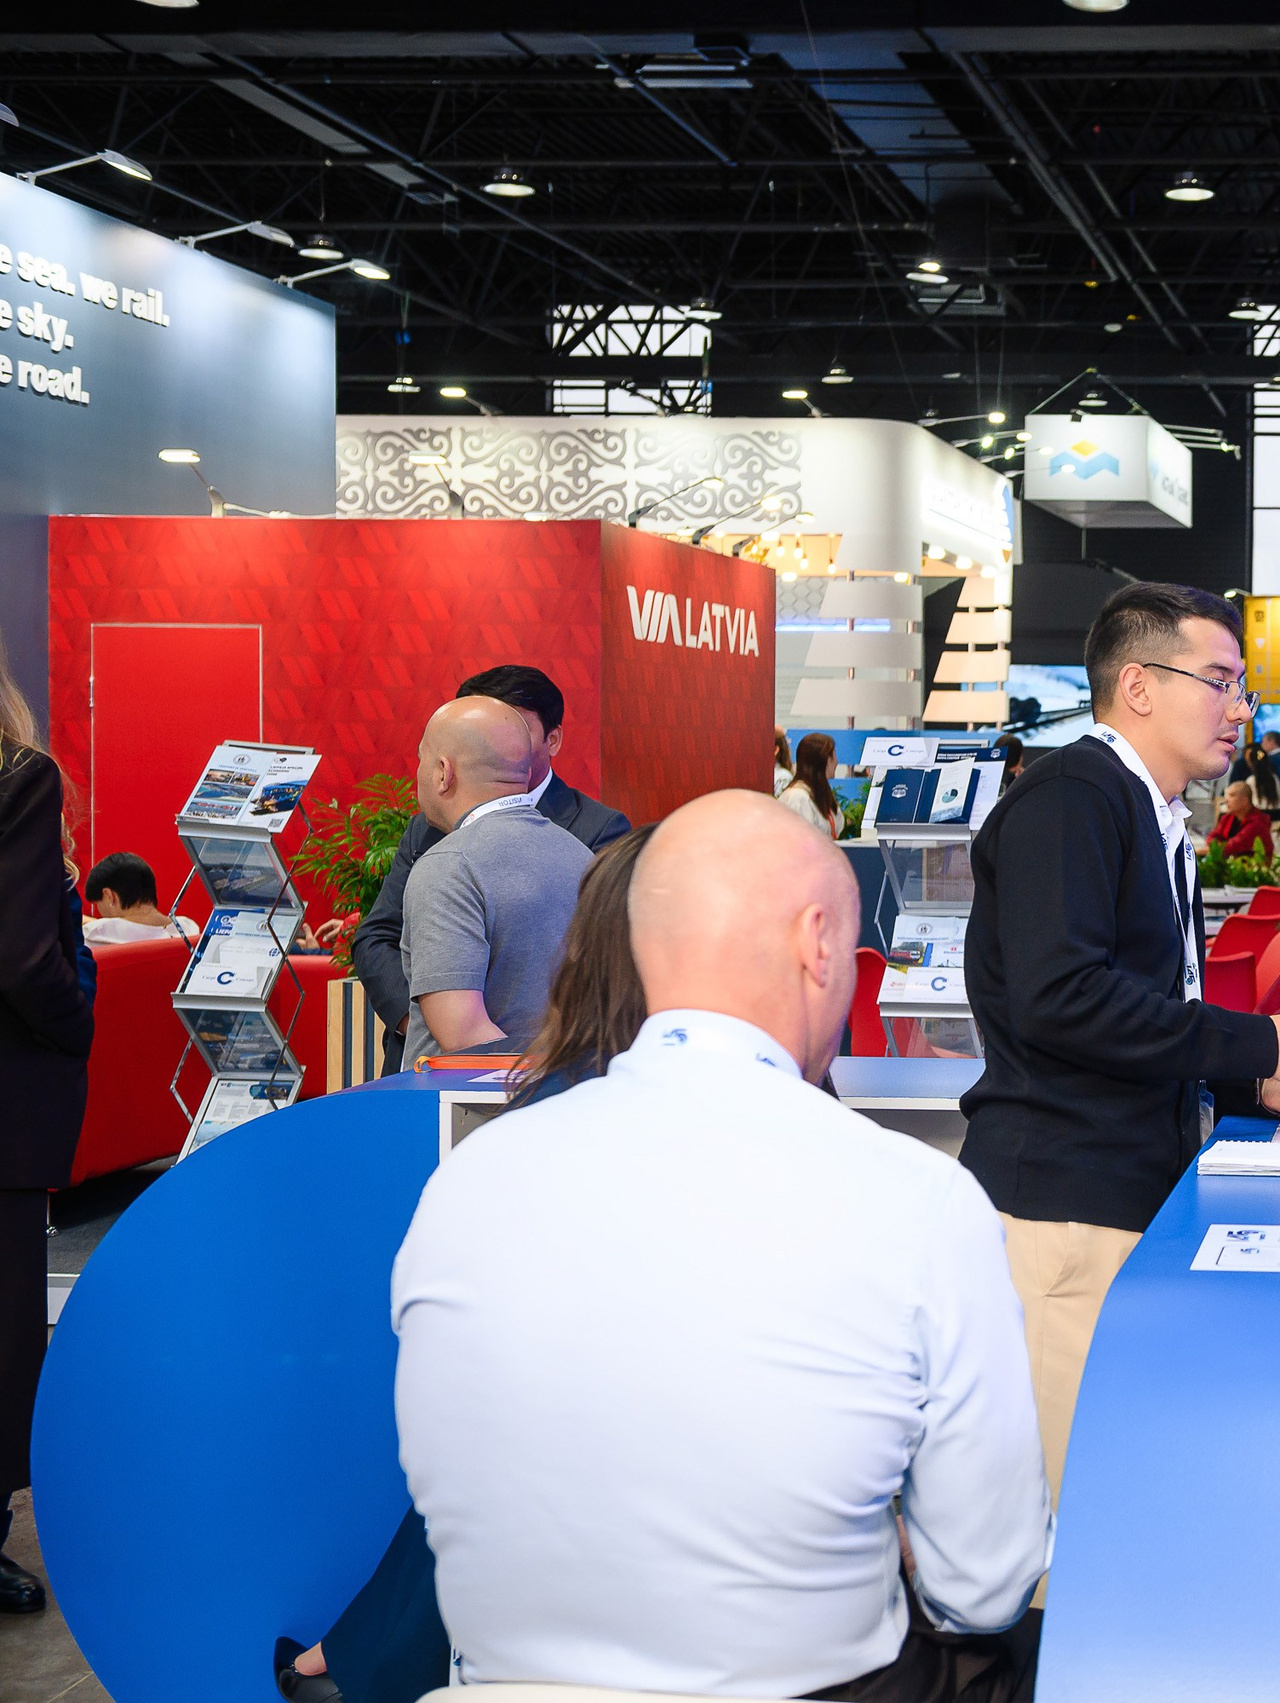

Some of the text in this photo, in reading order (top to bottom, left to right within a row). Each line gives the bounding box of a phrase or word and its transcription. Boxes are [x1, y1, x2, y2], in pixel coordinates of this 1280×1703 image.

[17, 250, 76, 296] sea.
[79, 271, 119, 309] we
[121, 287, 170, 327] rail.
[17, 302, 74, 352] sky.
[18, 360, 90, 404] road.
[685, 597, 760, 658] LATVIA
